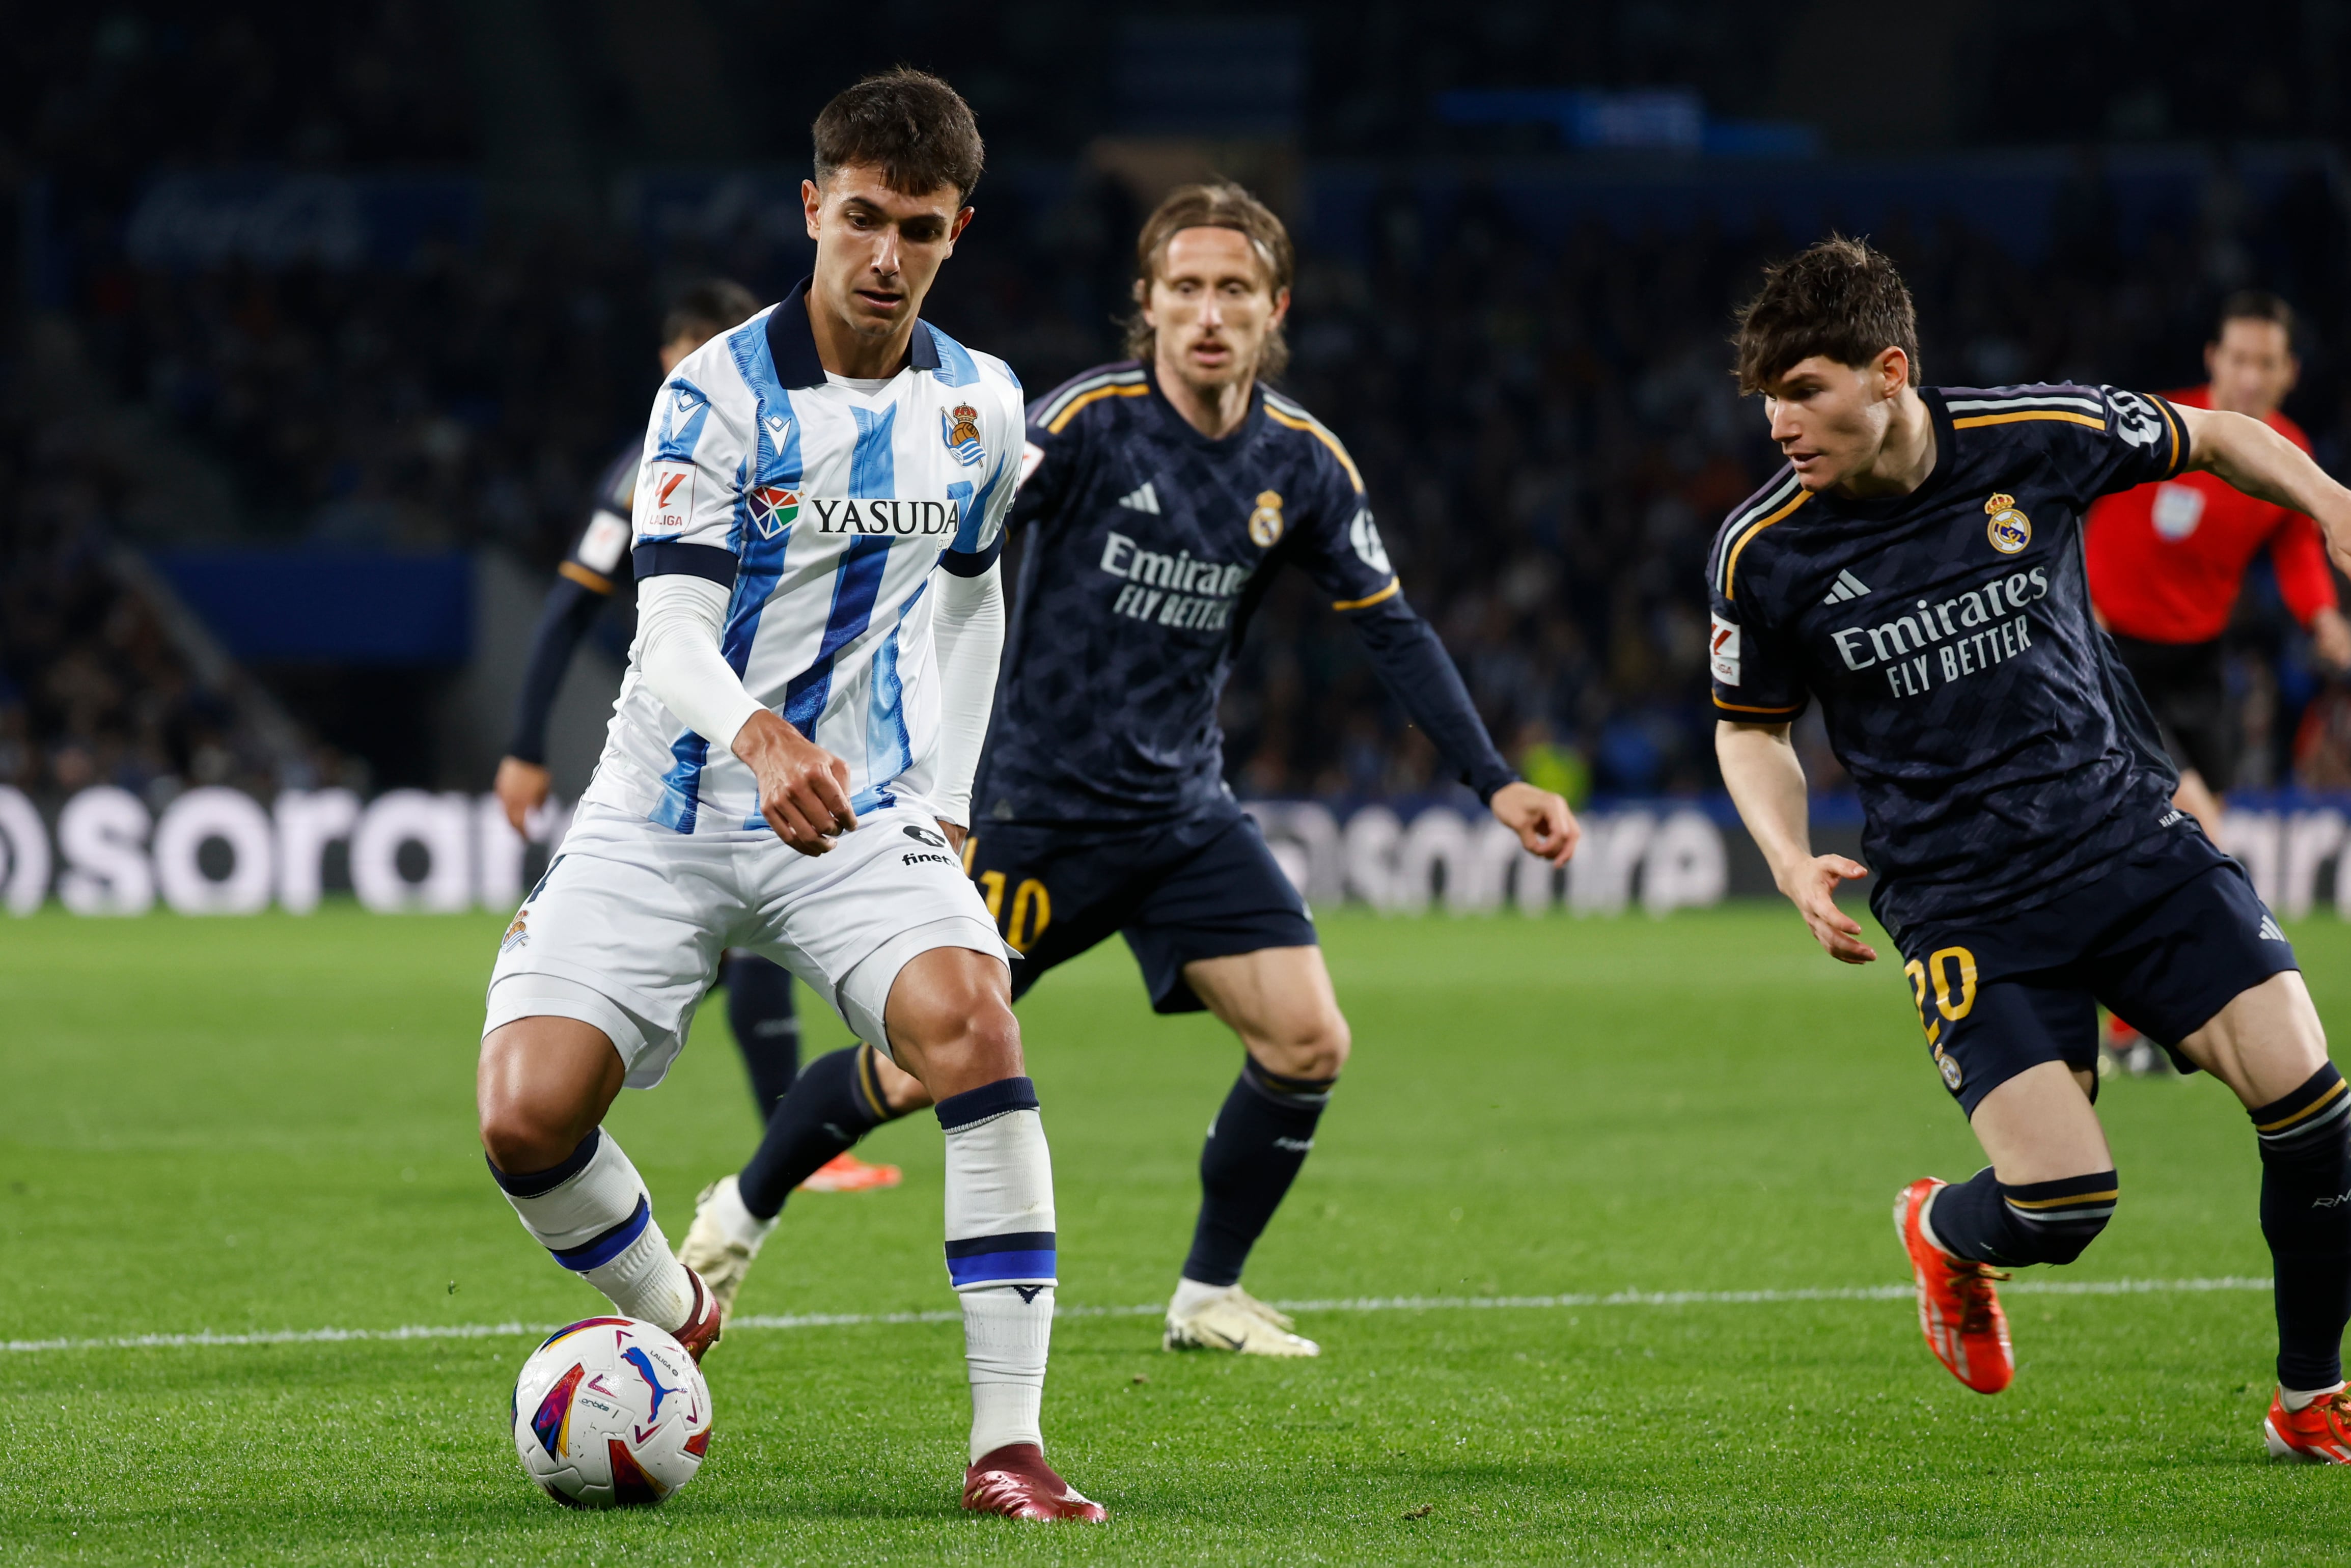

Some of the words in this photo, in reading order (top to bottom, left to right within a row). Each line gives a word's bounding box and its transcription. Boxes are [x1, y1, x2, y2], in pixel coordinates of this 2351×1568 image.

[649, 514, 683, 526] LALIGA
[811, 500, 958, 534] YASUDA
[1113, 584, 1163, 621] FLY
[1830, 566, 2048, 671] Emirates
[1886, 655, 1930, 698] FLY
[1939, 615, 2032, 683] BETTER
[58, 785, 573, 917] sorar
[979, 869, 1052, 954] 10
[1904, 946, 1978, 1047] 20
[650, 1350, 671, 1370] LALIGA
[579, 1398, 610, 1412] orbita
